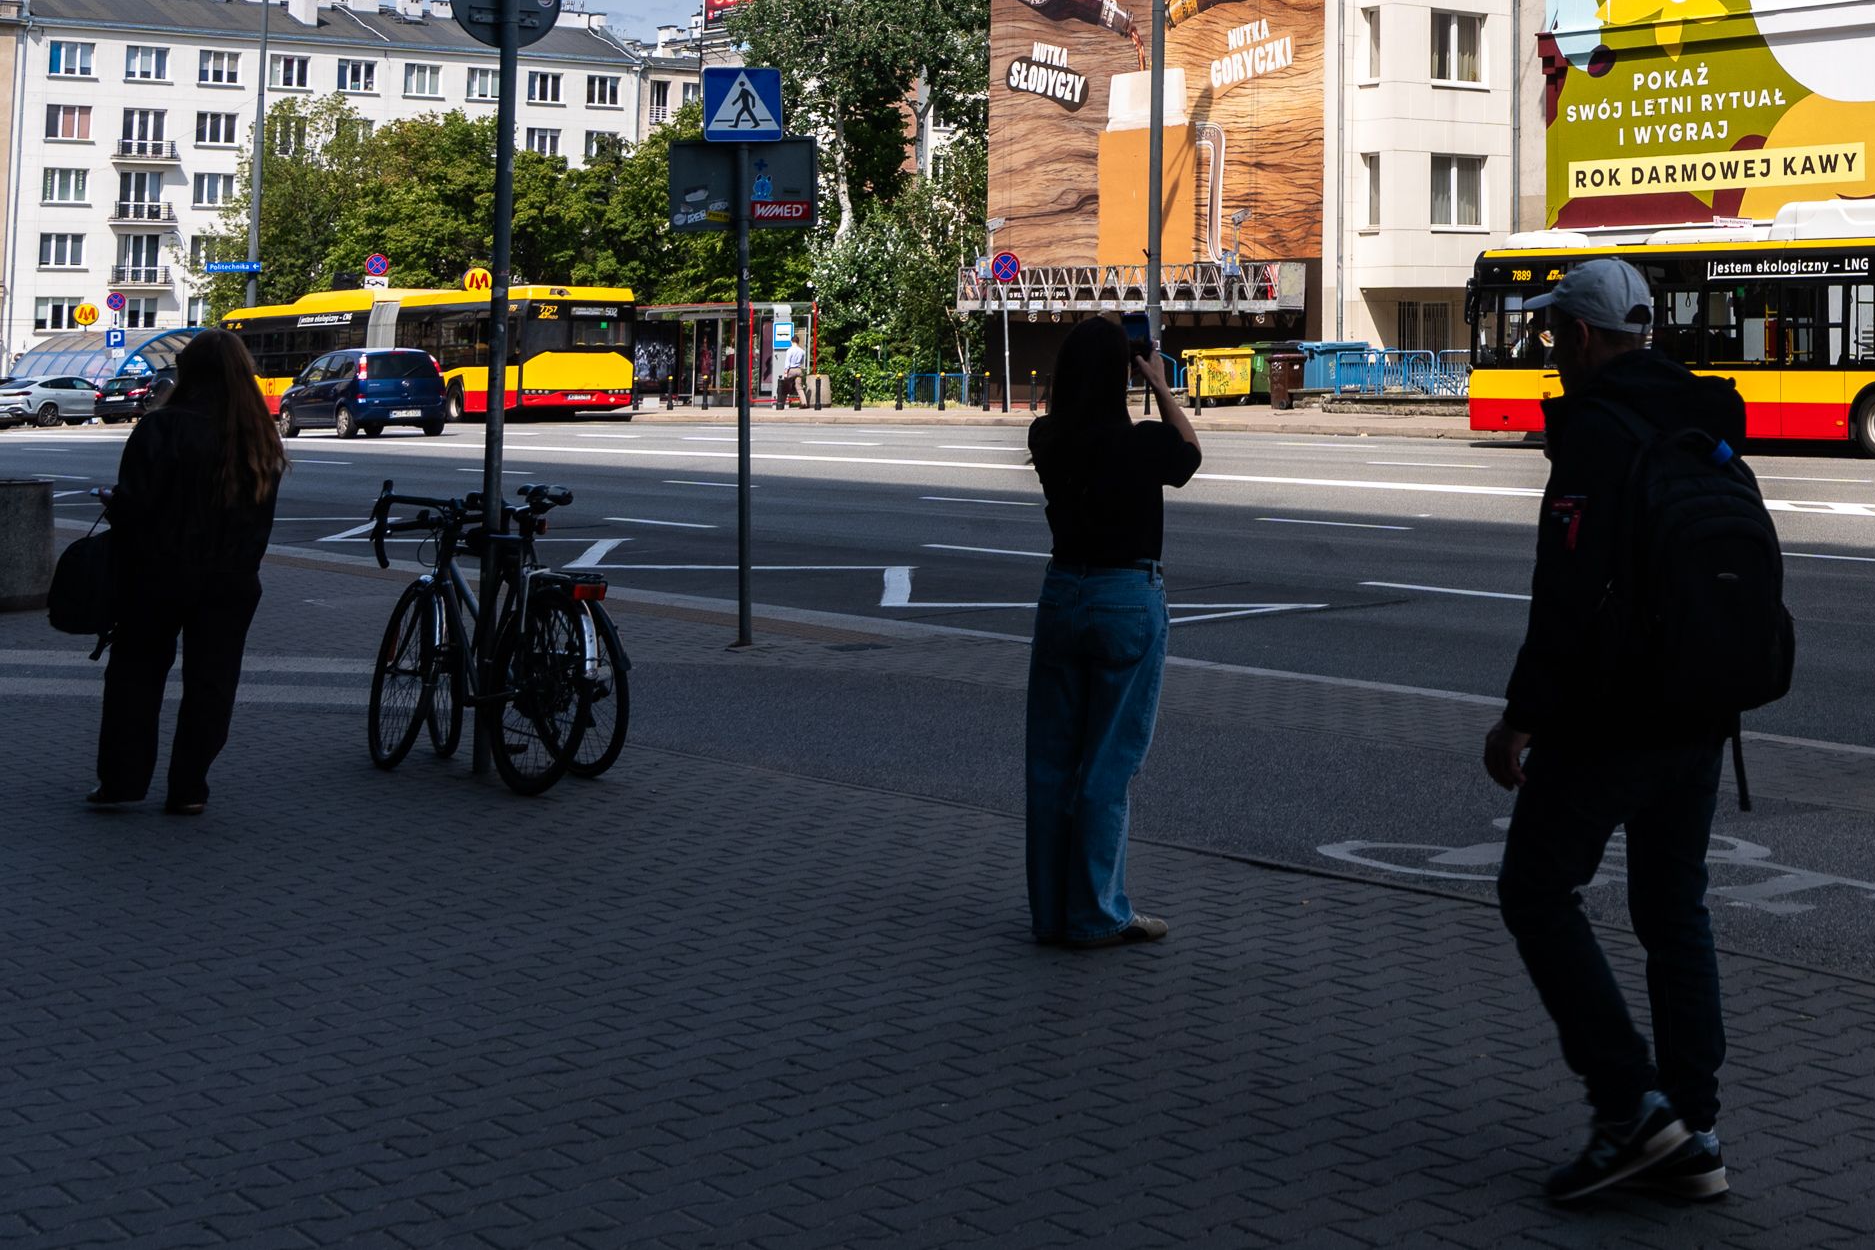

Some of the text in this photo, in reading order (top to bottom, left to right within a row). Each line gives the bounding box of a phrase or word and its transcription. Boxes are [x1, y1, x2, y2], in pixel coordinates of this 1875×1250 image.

[1227, 18, 1270, 51] NUTKA
[1031, 41, 1068, 68] NUTKA
[1210, 35, 1293, 90] GORYCZKI
[1009, 60, 1086, 103] SŁODYCZY
[1633, 61, 1709, 91] POKAŻ
[1566, 87, 1786, 123] SWÓJ LETNI RYTUAŁ
[1619, 120, 1729, 146] I WYGRAJ
[1575, 152, 1858, 188] ROK DARMOWEJ KAWY
[1512, 270, 1532, 281] 7889
[1712, 261, 1752, 276] jestem
[1756, 259, 1829, 275] ekologiczny
[1844, 257, 1869, 271] LNG
